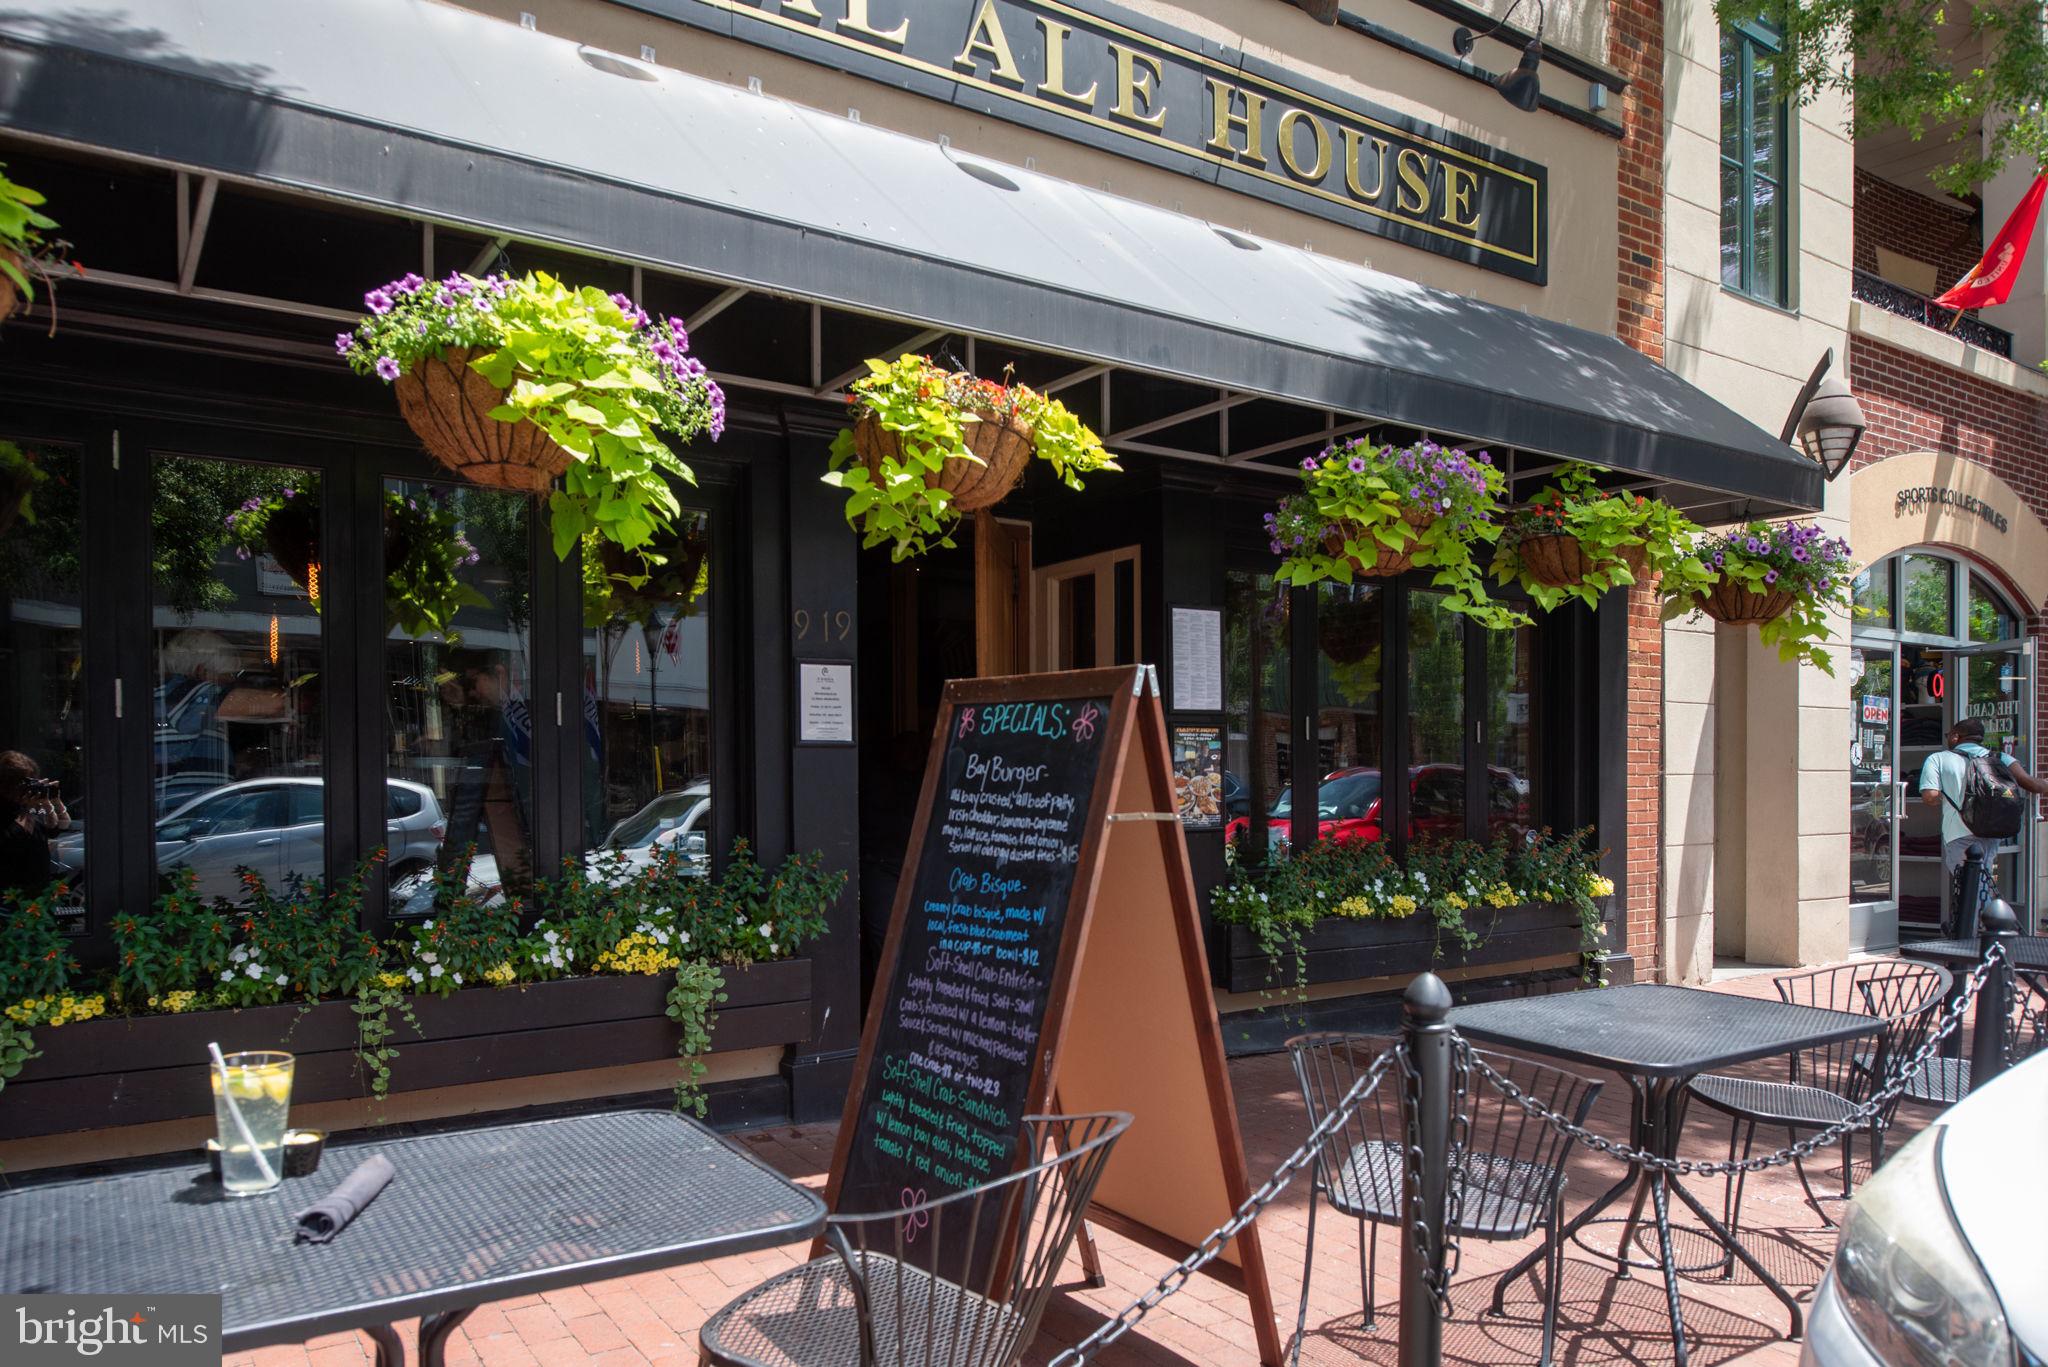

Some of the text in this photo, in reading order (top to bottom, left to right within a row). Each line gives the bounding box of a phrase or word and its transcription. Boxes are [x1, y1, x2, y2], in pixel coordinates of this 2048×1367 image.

[954, 0, 1168, 129] ALE
[1207, 76, 1482, 233] HOUSE
[1896, 487, 2008, 534] SPORTS COLLECTIBLES
[794, 609, 851, 642] 919
[980, 703, 1071, 740] SPECIALS:
[1863, 706, 1889, 720] OPEN
[966, 753, 990, 792] Bay
[949, 867, 977, 892] Crab
[969, 923, 986, 938] blue
[1005, 906, 1032, 921] made
[1033, 905, 1047, 926] w/
[981, 944, 994, 955] or
[974, 961, 998, 982] Crab
[934, 1042, 979, 1073] asparagus
[932, 1078, 957, 1105] Crab
[953, 1071, 964, 1083] or
[875, 1111, 887, 1128] w/
[887, 1114, 912, 1138] lemon
[913, 1123, 931, 1152] bay
[971, 1128, 1006, 1160] topped
[873, 1132, 904, 1158] tomato
[915, 1156, 931, 1174] red
